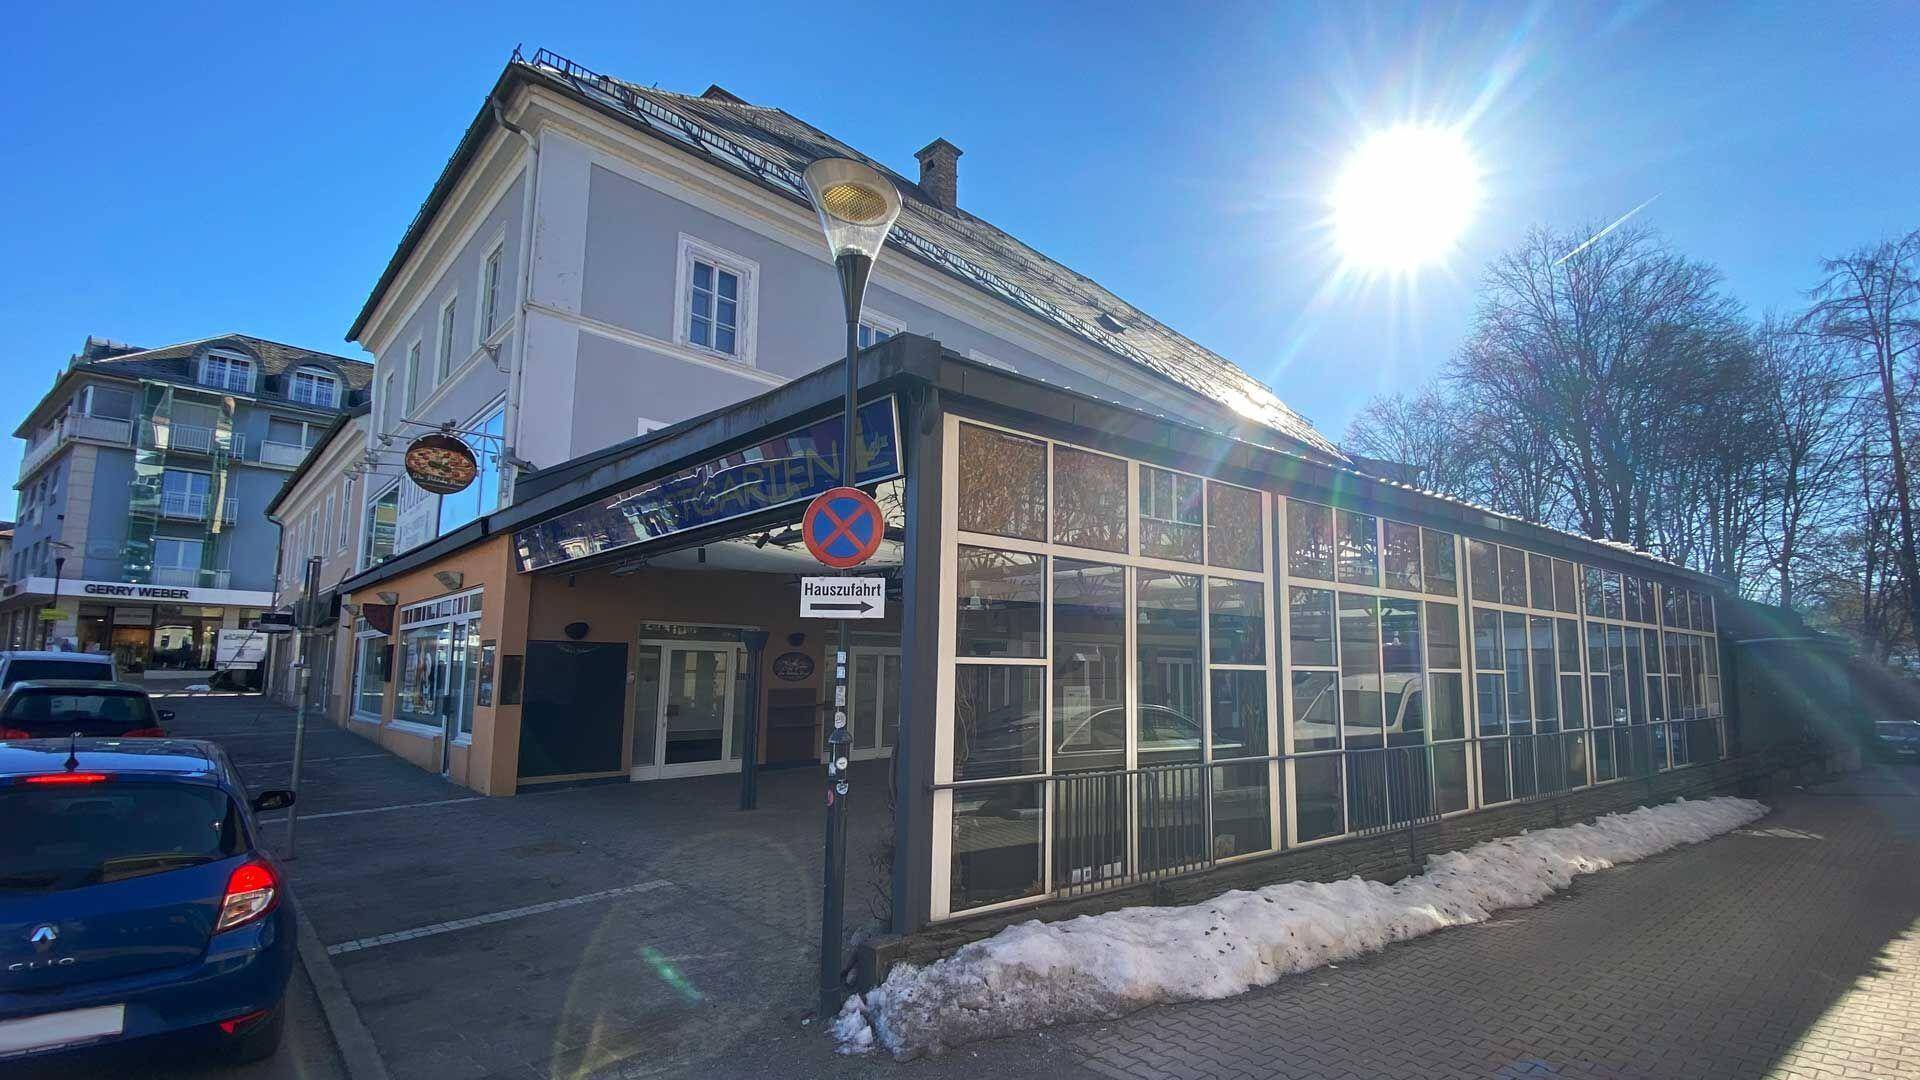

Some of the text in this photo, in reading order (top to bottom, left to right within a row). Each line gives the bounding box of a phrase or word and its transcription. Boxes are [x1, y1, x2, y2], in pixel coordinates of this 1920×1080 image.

[84, 583, 189, 600] GERRY WEBER
[804, 582, 881, 597] Hauszufahrt
